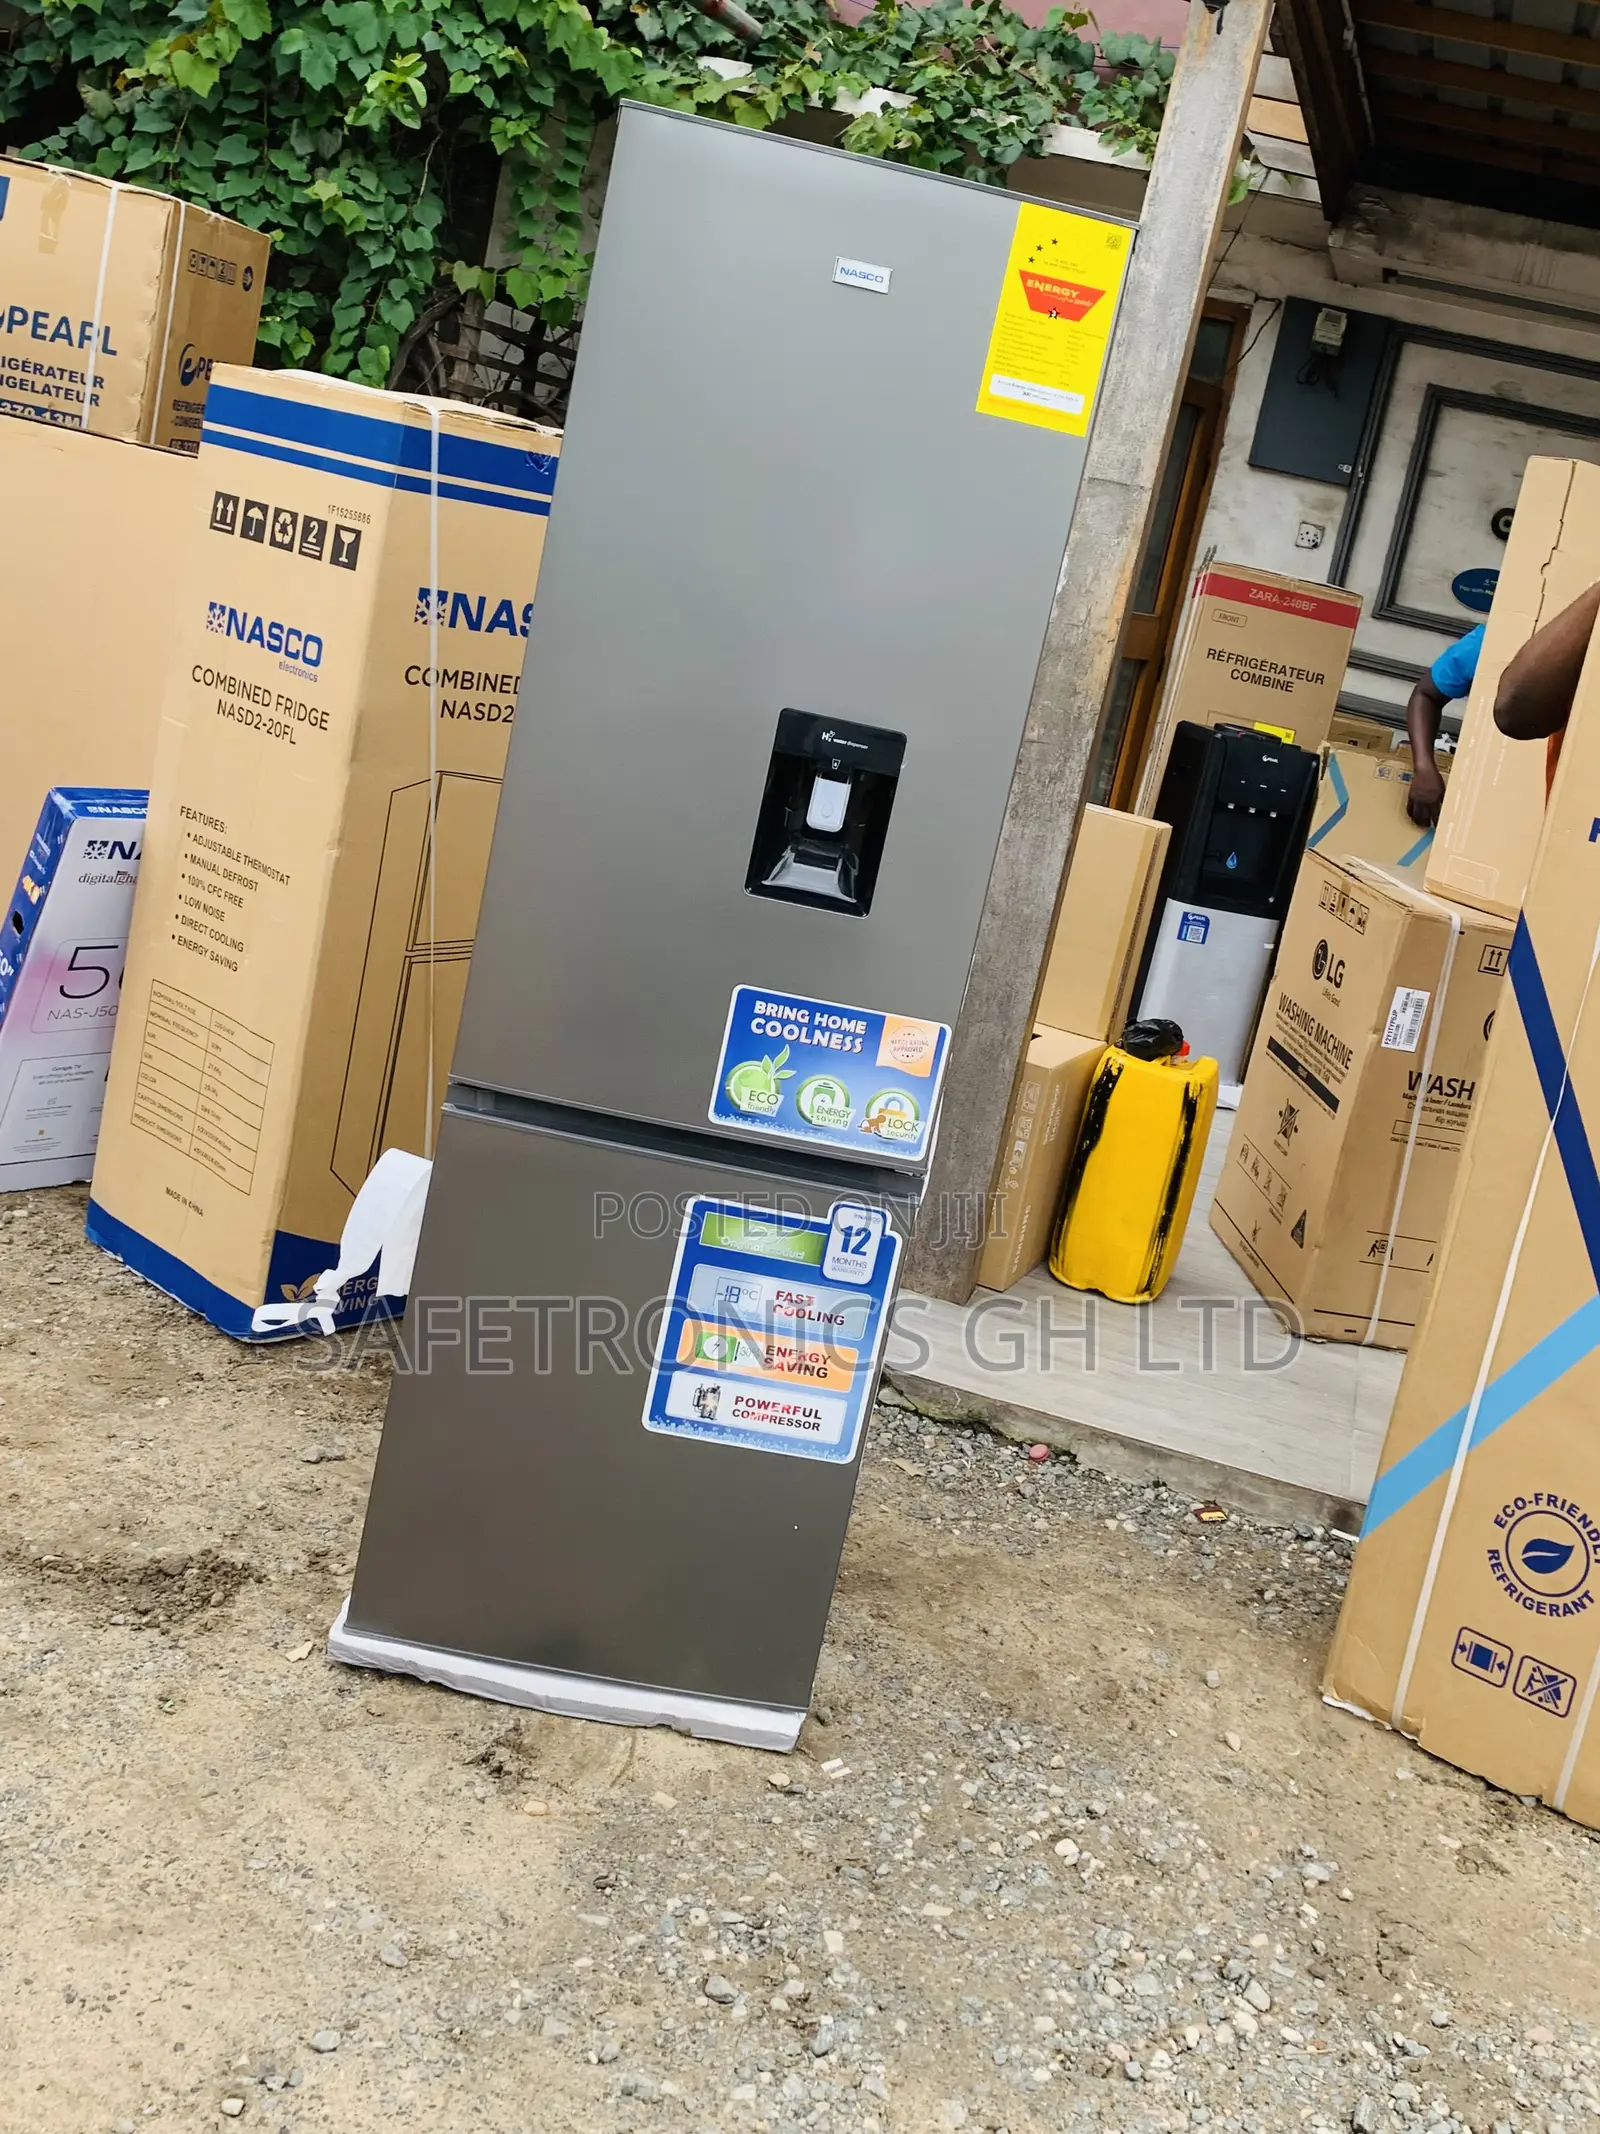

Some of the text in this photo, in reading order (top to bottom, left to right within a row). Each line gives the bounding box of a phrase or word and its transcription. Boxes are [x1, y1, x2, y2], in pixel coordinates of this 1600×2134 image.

[840, 267, 884, 283] NASCO
[1026, 279, 1080, 298] ENERGY
[6, 305, 117, 356] PEARL
[225, 607, 323, 667] NASCO
[278, 660, 319, 683] electronics
[1206, 647, 1325, 685] RÉFRIGÉRATEUR
[1230, 668, 1295, 692] COMBINE
[192, 664, 330, 731] COMBINED FRIDGE
[217, 699, 297, 745] NASD2-20FL
[180, 805, 228, 834] FEATURES:
[190, 853, 259, 892] MANUAL DEFROST
[192, 833, 291, 886] ADJUSTABLE THERMOSTAT
[188, 874, 244, 908] 100% CFC FREE
[184, 895, 225, 922] LOW NOISE
[181, 915, 244, 952] DIRECT COOLING
[177, 935, 238, 972] ENERGY SAVING
[1326, 953, 1346, 989] LG
[753, 1000, 867, 1035] BRING HOME
[1279, 991, 1316, 1037] WASHING
[1314, 1022, 1353, 1070] MACHINE
[750, 1018, 864, 1054] COOLNESS
[749, 1090, 778, 1105] ECO
[1408, 1070, 1476, 1100] WASH
[747, 1102, 776, 1115] friendly
[816, 1106, 852, 1118] ENERGY
[816, 1116, 848, 1128] saving
[886, 1130, 918, 1140] security
[888, 1118, 919, 1132] LOCK
[165, 1186, 181, 1202] MADE
[188, 1200, 204, 1217] CHINA
[841, 1226, 872, 1256] 12
[831, 1256, 867, 1269] MONTHS
[775, 1290, 816, 1306] FAST
[773, 1304, 845, 1326] COOLING
[763, 1358, 828, 1379] SAVING
[766, 1344, 831, 1365] ENERGY
[732, 1409, 820, 1432] COMPRESSOR
[735, 1396, 822, 1420] POWERFUL
[1487, 1549, 1595, 1617] REFRIGERANT
